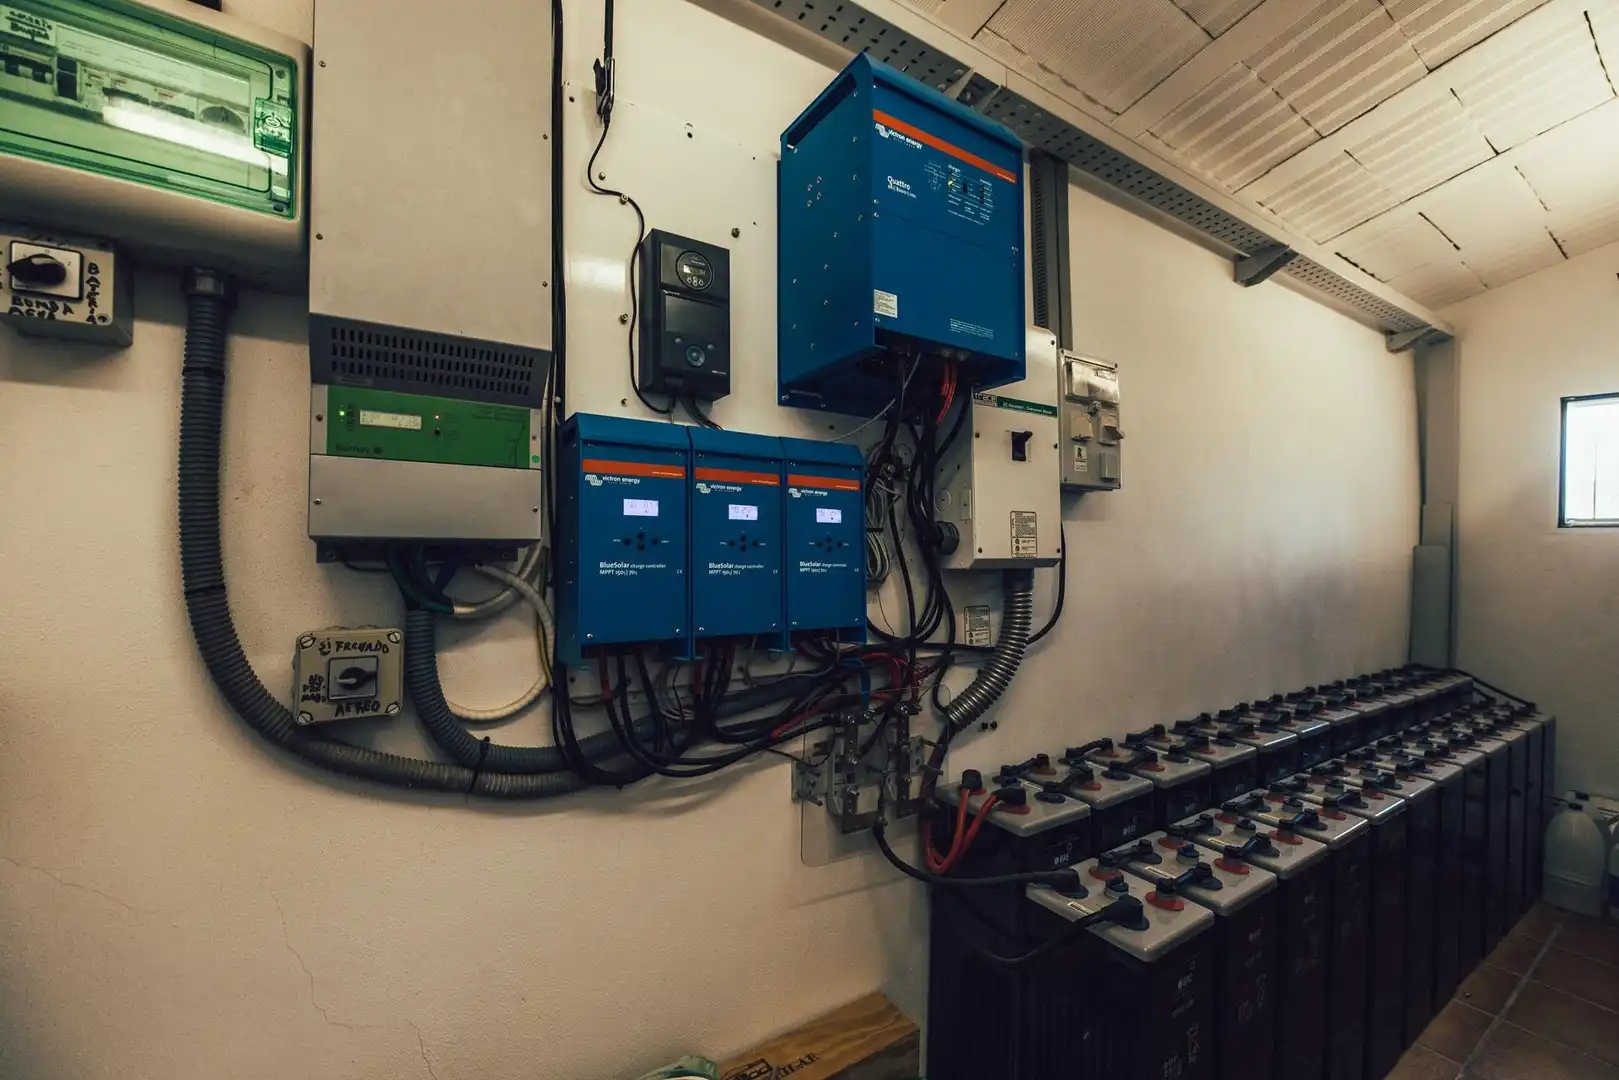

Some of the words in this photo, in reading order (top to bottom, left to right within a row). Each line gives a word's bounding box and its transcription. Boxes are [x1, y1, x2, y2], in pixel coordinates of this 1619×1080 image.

[887, 175, 911, 191] Quattro
[622, 476, 640, 485] energy
[599, 561, 630, 569] BlueSolar
